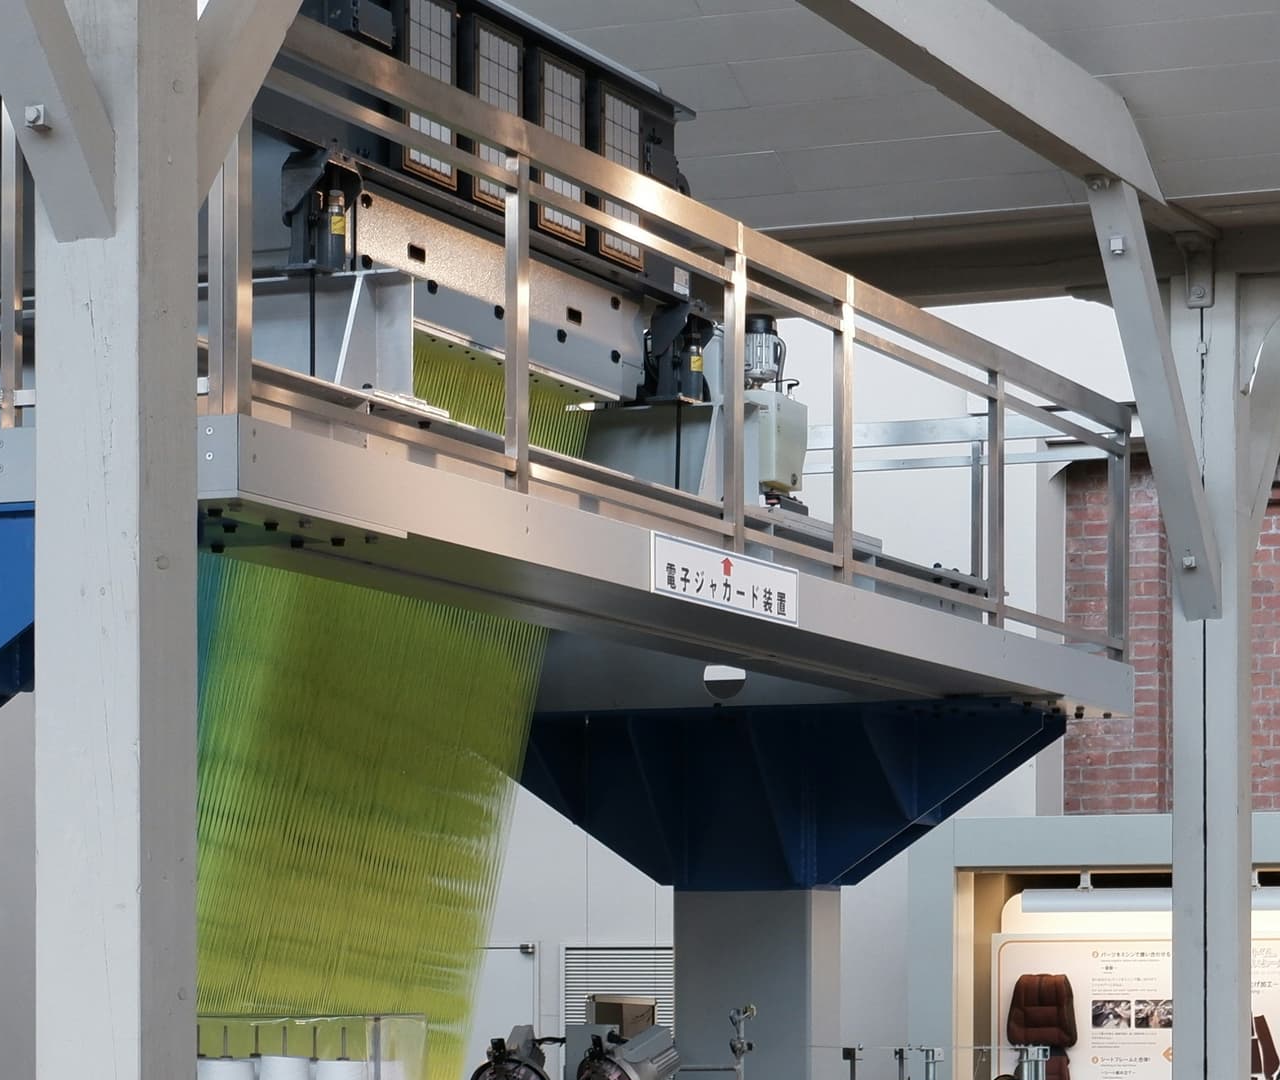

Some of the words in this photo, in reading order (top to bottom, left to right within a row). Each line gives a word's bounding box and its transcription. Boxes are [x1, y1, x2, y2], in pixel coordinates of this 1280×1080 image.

[666, 562, 787, 616] 電子ジャカード装置
